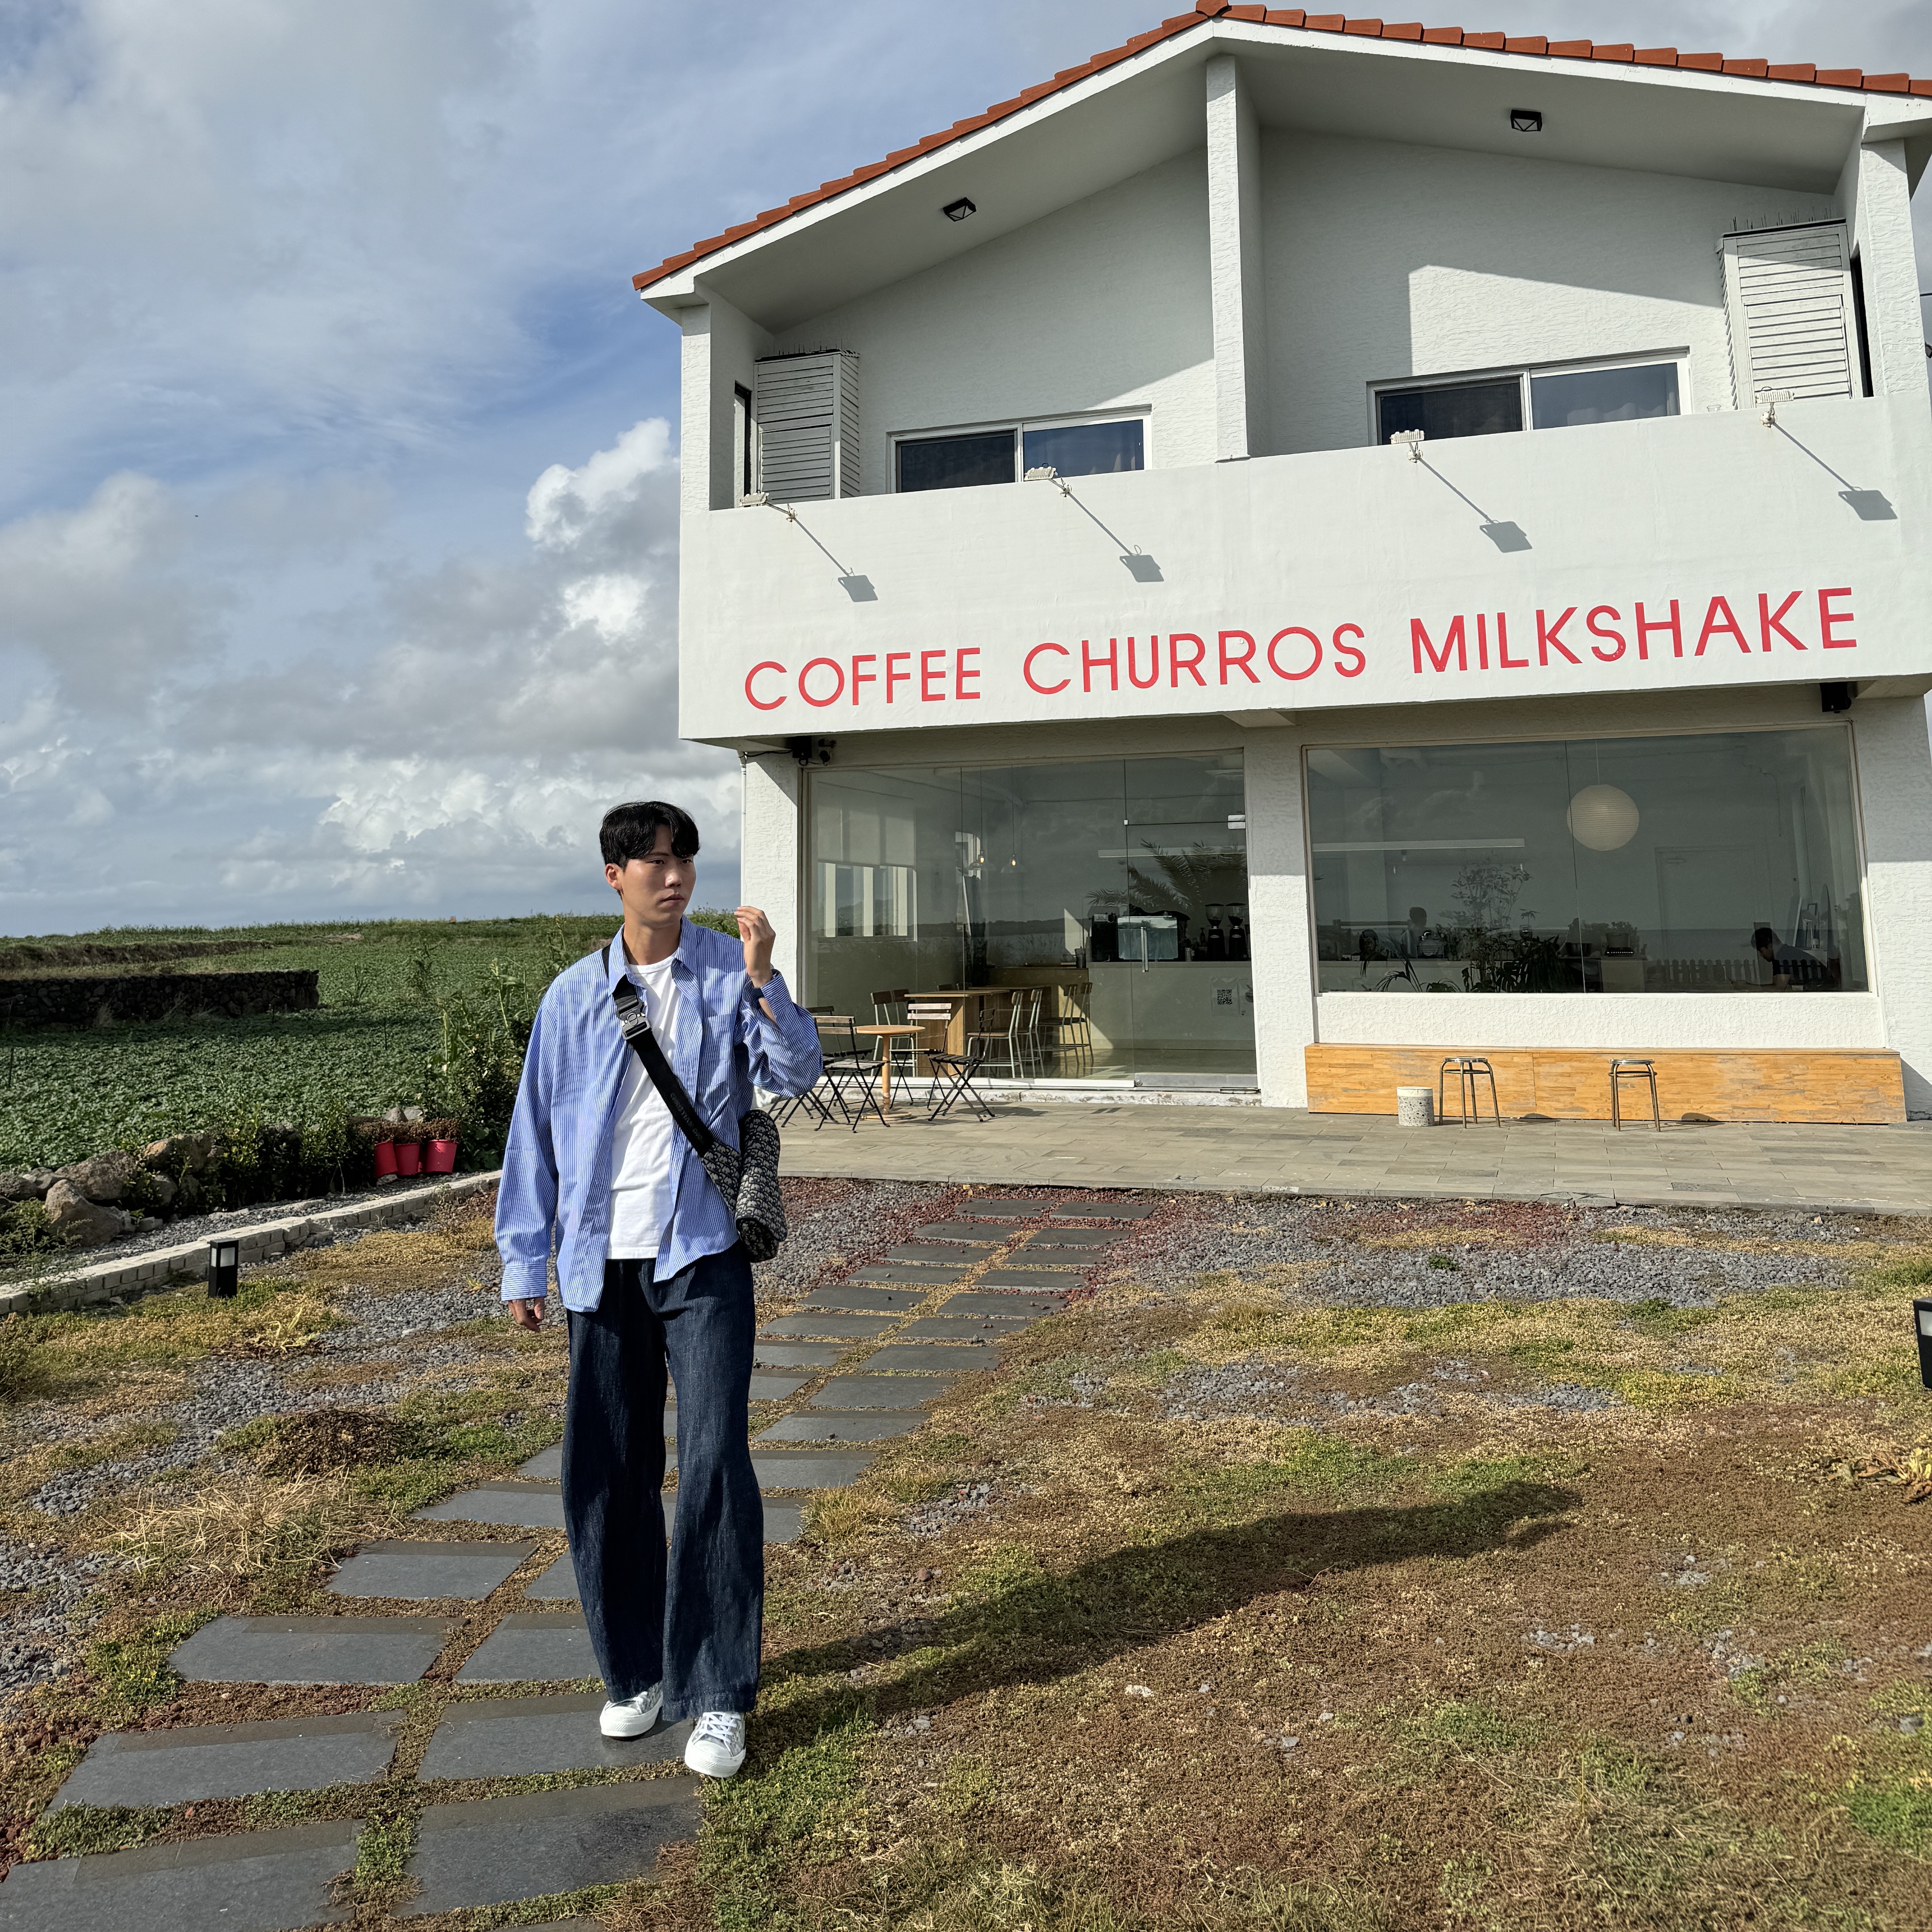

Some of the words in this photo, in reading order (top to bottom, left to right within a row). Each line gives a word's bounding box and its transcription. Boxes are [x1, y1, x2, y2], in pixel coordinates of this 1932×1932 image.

[745, 648, 981, 710] COFFEE
[1024, 623, 1365, 695] CHURROS
[1411, 588, 1857, 673] MILKSHAKE
[670, 1092, 694, 1127] CHRISTIAN
